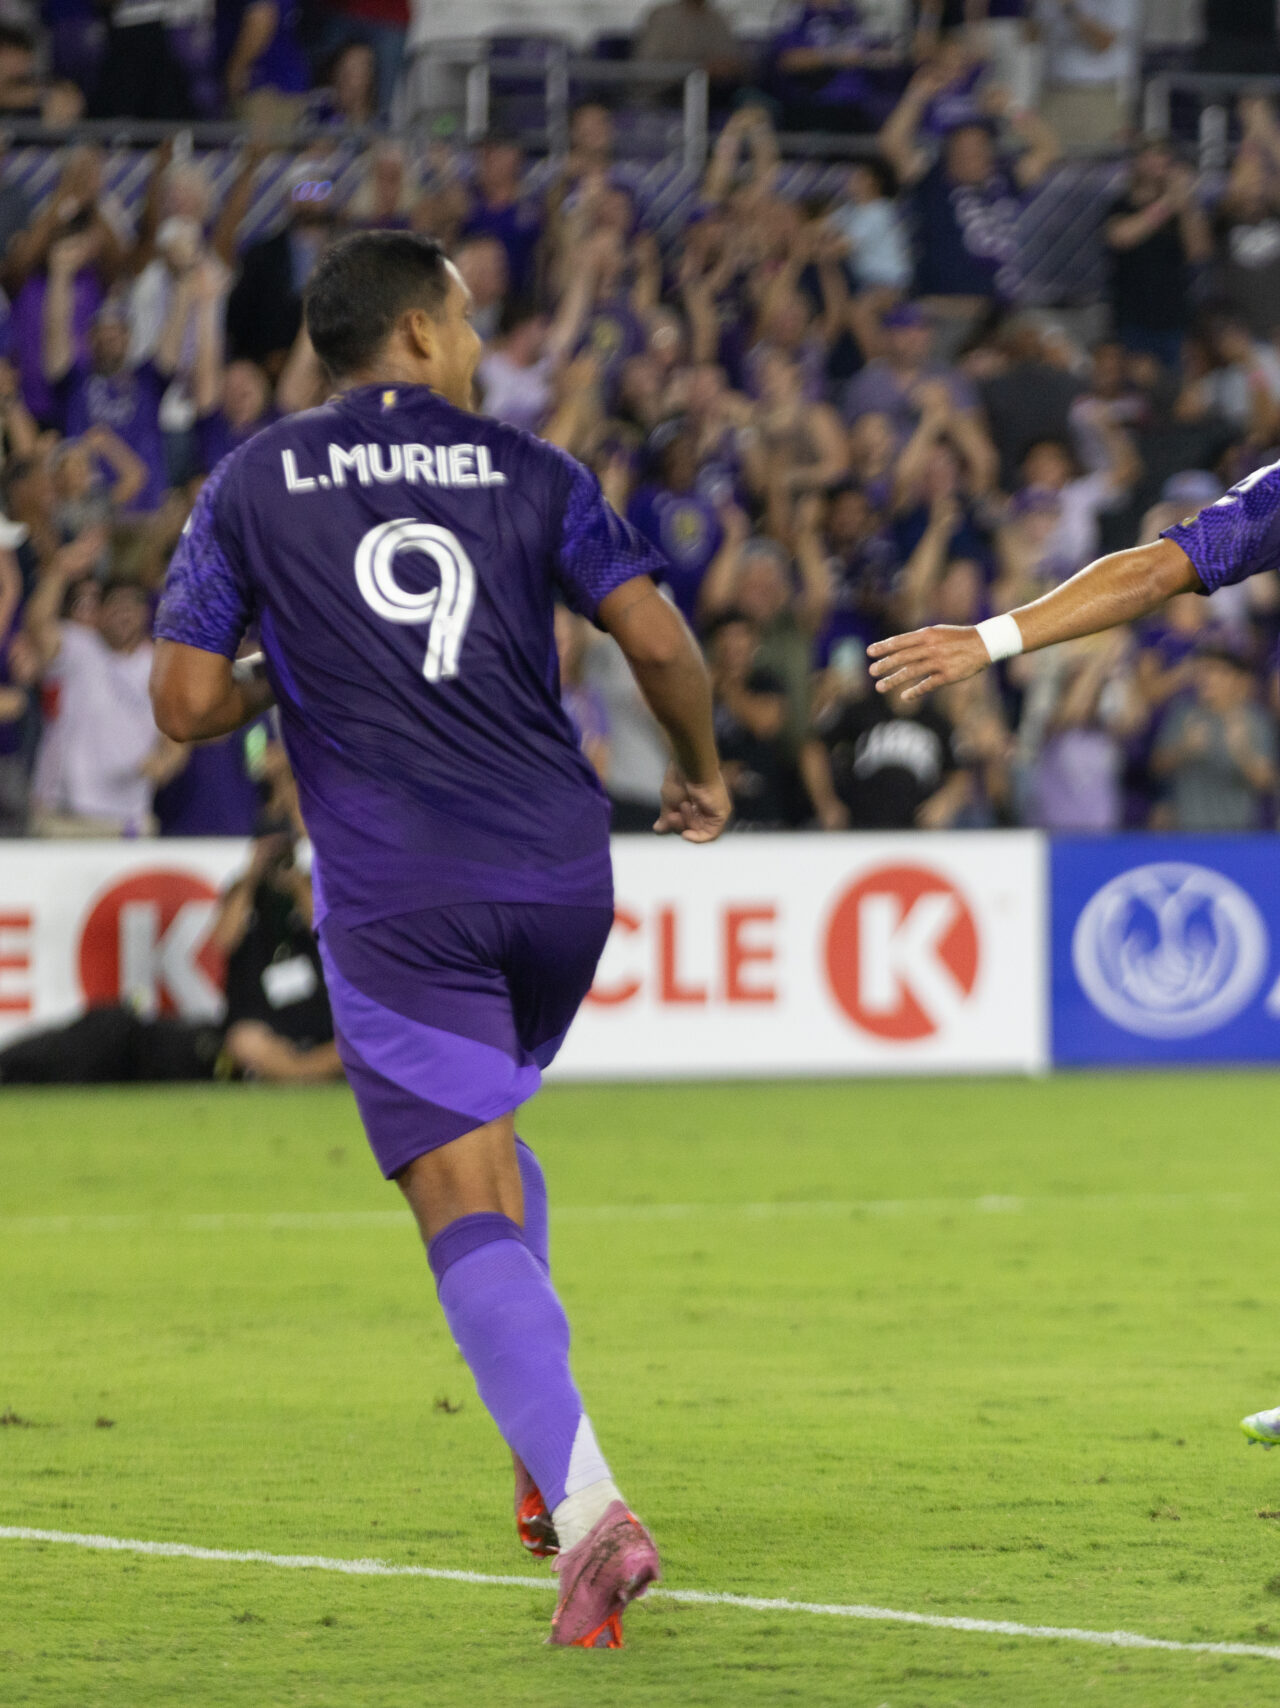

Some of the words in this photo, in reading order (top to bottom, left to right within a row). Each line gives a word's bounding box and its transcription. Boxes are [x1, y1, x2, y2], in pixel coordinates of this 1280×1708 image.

[281, 442, 508, 494] L.MURIEL
[353, 517, 476, 683] 9
[584, 904, 779, 1010] CLE
[853, 887, 970, 1036] K
